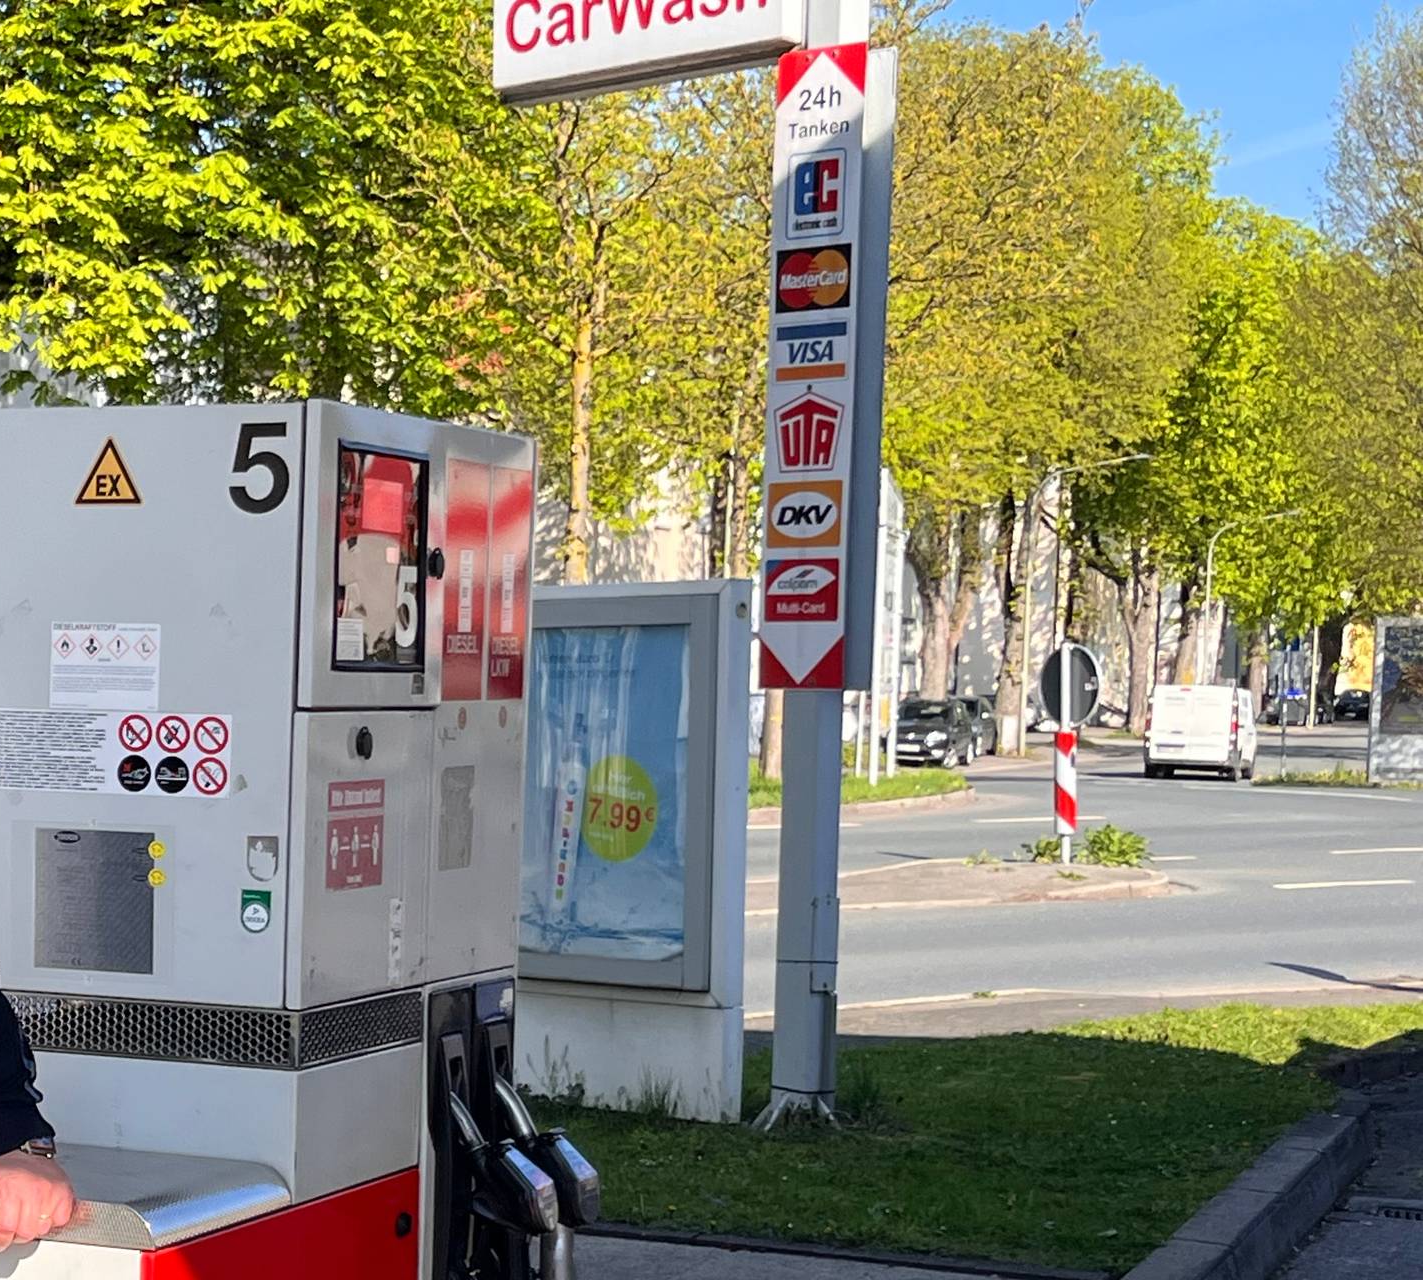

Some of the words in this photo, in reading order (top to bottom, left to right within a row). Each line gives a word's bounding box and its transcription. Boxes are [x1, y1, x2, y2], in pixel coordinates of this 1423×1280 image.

[505, 0, 767, 54] CarWa
[799, 84, 841, 111] 24h
[788, 119, 850, 140] Tanken
[779, 268, 848, 291] MasterCard
[787, 340, 834, 364] VISA
[779, 399, 839, 467] UTA
[228, 421, 290, 514] 5
[95, 474, 121, 497] EX
[777, 504, 832, 526] DKV
[394, 565, 418, 648] 5
[446, 634, 480, 654] DIESEL
[491, 636, 521, 656] DIESEL
